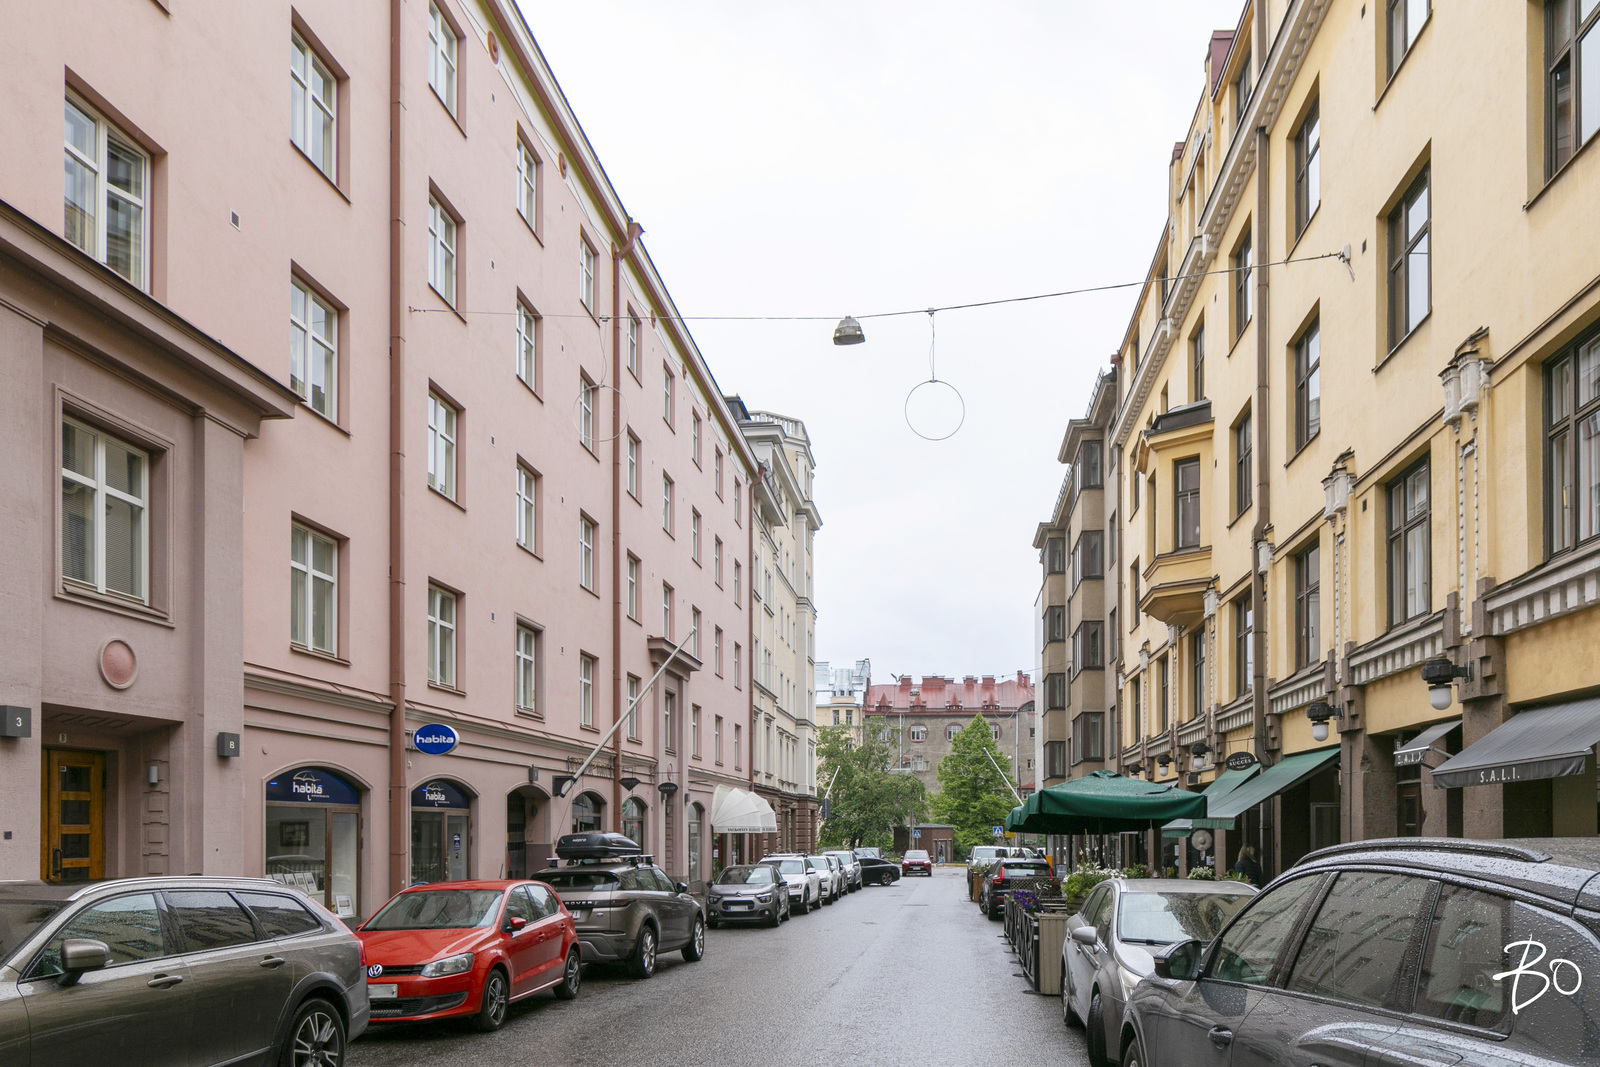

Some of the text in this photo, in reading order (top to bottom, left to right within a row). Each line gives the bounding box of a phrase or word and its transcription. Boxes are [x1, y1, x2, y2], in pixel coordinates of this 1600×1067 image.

[16, 717, 22, 727] 3
[416, 734, 454, 744] habita
[229, 741, 235, 749] B
[1480, 767, 1520, 783] S.A.L.I.
[292, 781, 323, 794] habita
[425, 791, 446, 801] habita
